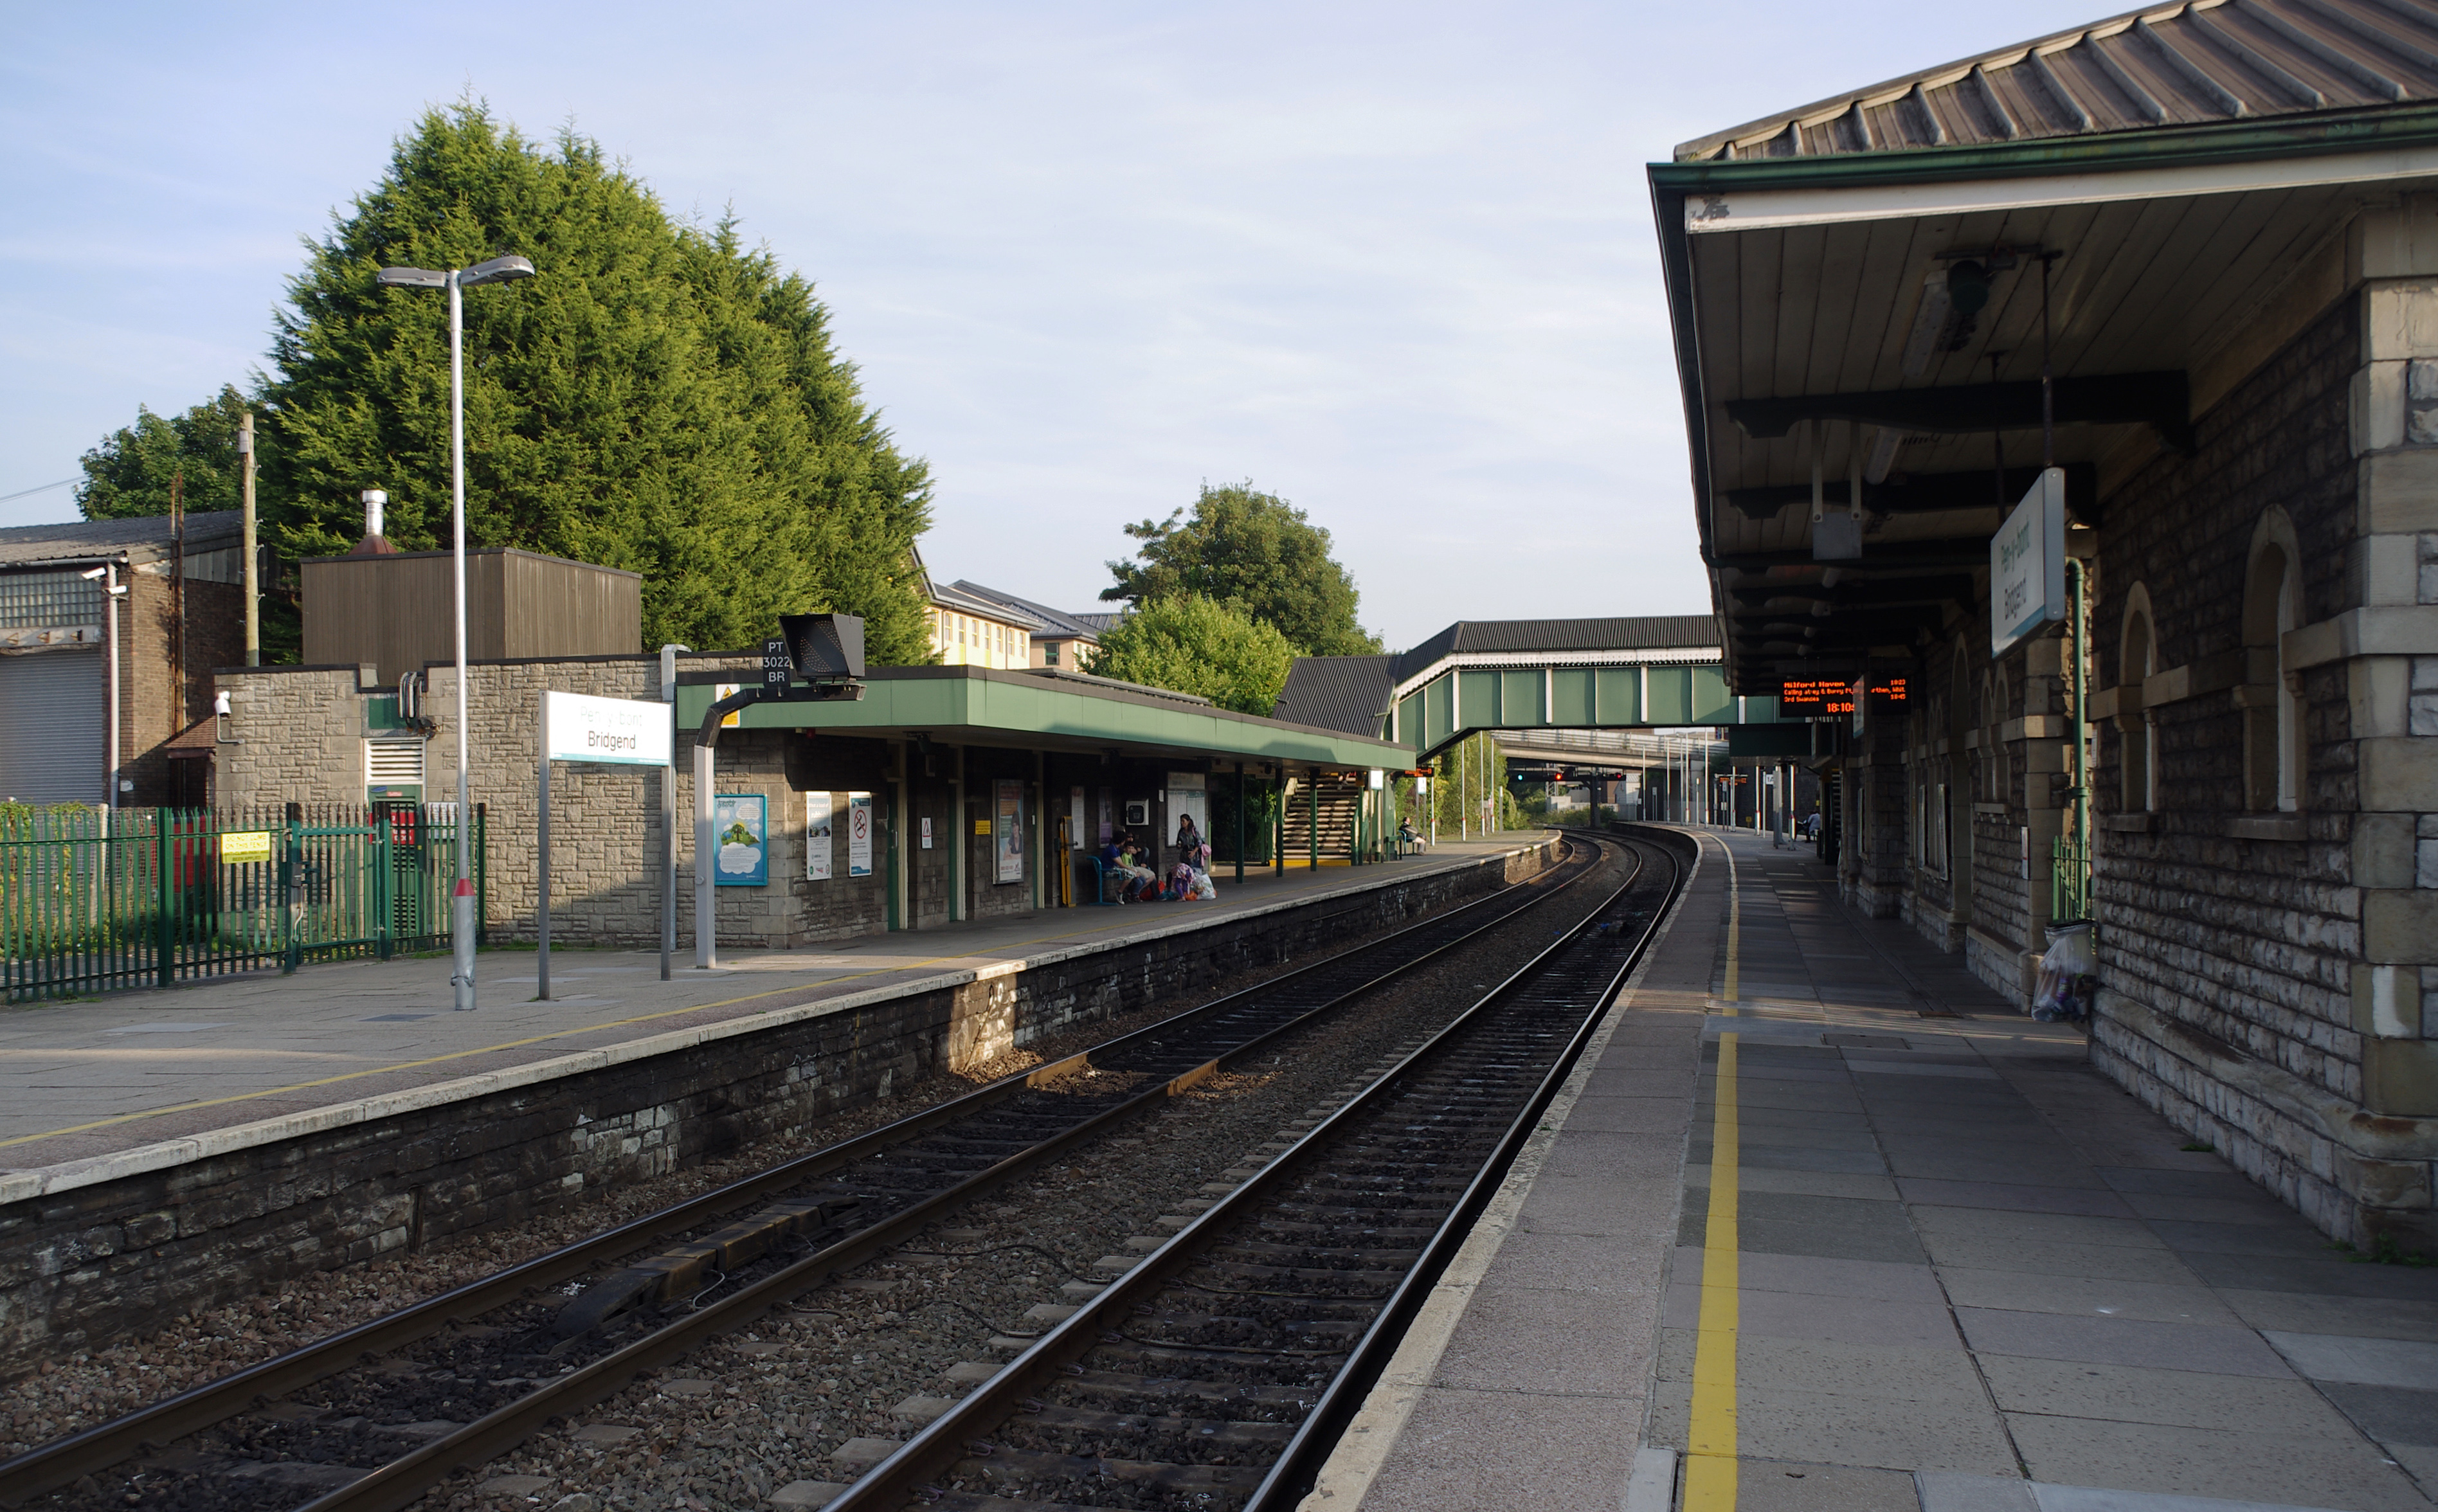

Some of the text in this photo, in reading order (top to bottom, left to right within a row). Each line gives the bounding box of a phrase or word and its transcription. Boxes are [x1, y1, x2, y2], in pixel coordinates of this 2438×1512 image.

[768, 642, 784, 652] PT
[763, 656, 790, 668] 3022
[768, 672, 785, 683] BR
[588, 730, 636, 752] Bridgend
